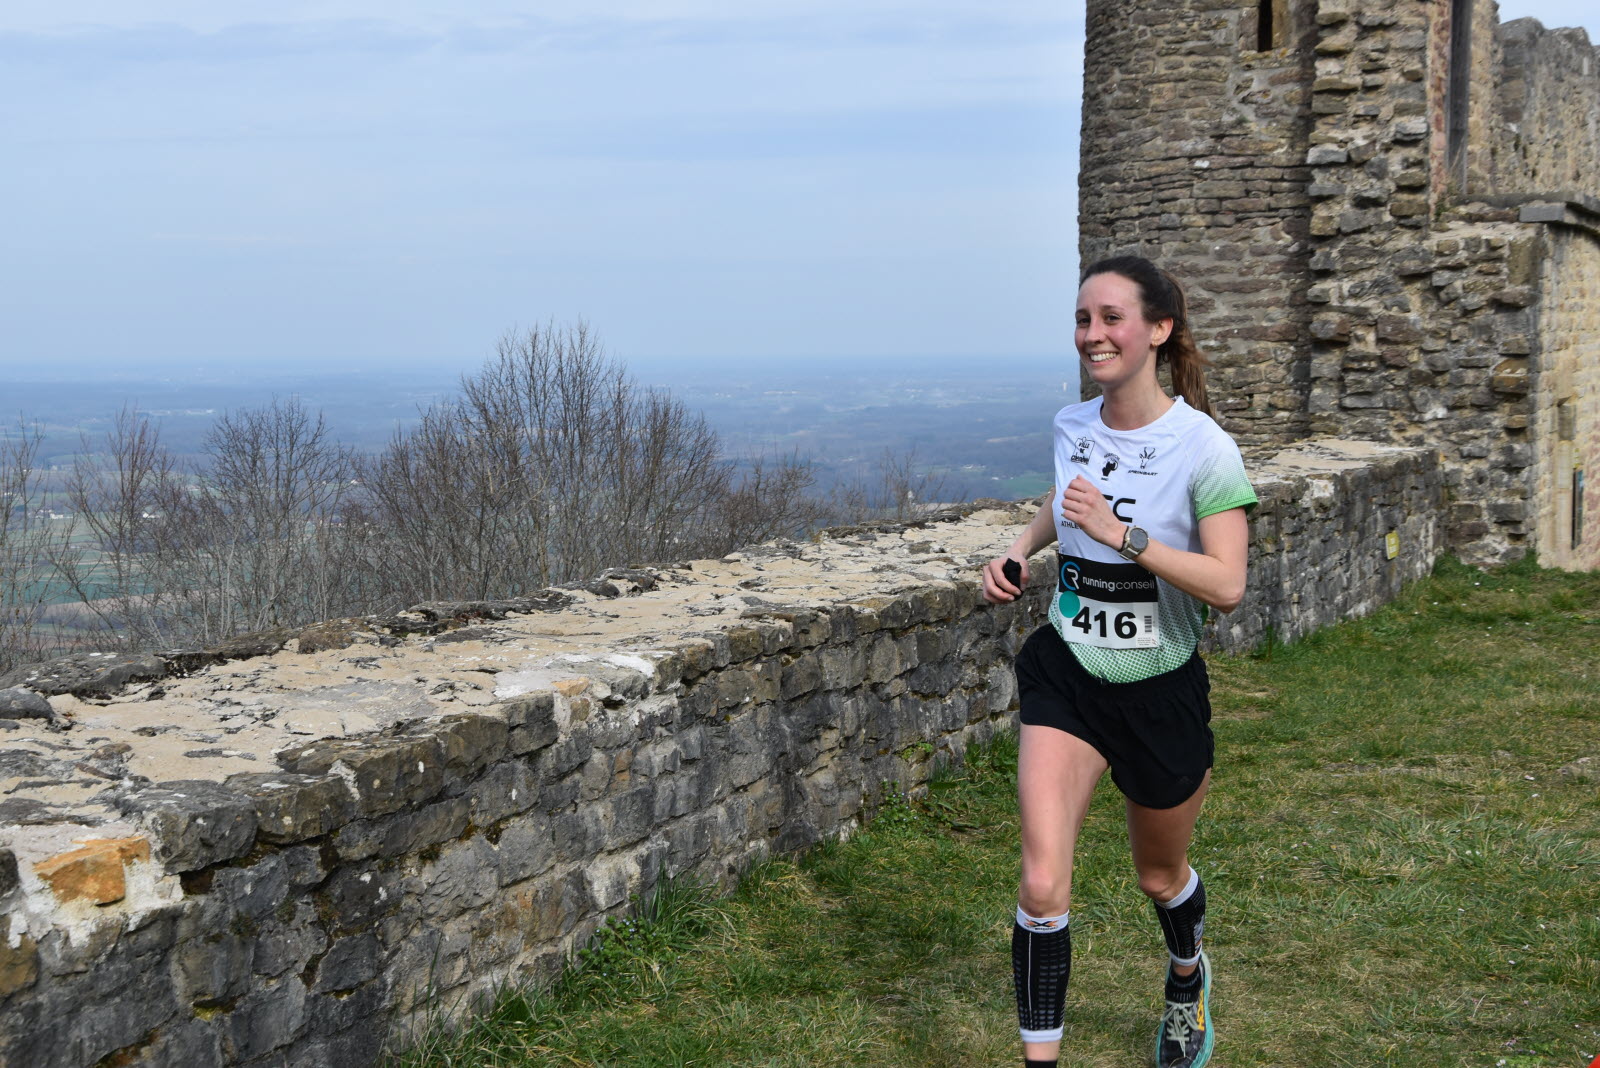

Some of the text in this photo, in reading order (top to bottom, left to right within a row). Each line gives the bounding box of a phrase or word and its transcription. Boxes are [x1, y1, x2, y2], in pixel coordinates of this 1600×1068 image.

[1061, 520, 1082, 530] ATHLE
[1082, 576, 1154, 592] runningconseil
[1072, 606, 1137, 639] 416
